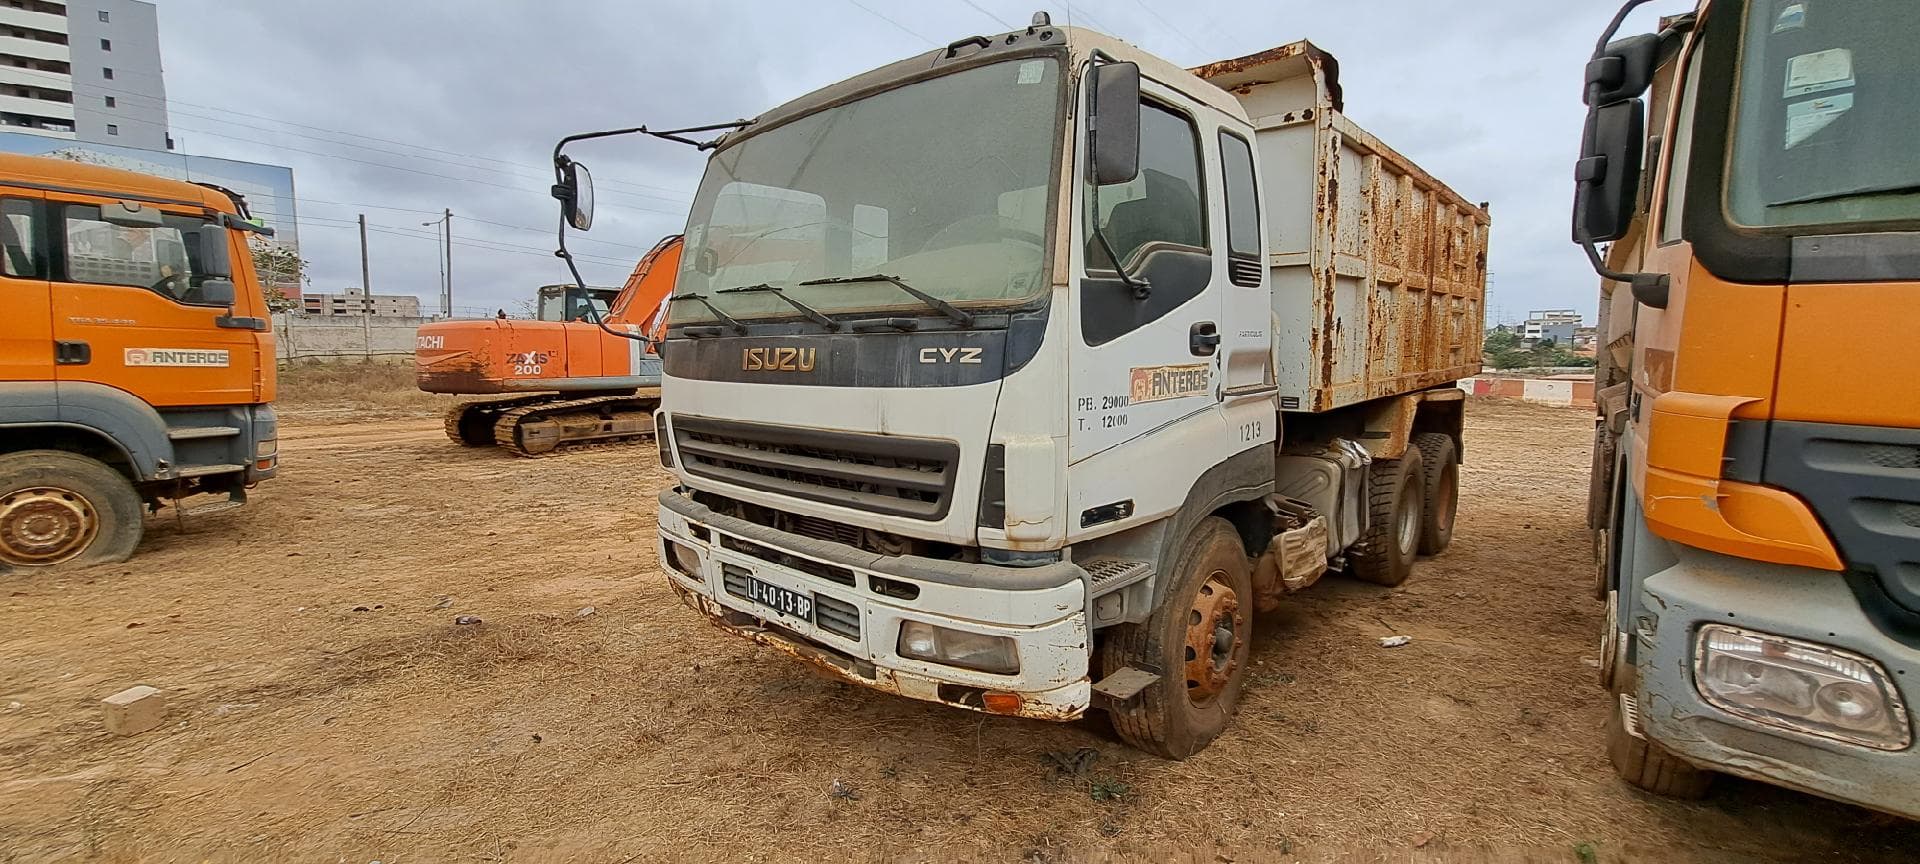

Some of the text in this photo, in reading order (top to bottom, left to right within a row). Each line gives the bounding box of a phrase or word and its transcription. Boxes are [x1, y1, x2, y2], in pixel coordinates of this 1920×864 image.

[152, 351, 229, 364] ANTEROS
[742, 347, 817, 372] ISUZU
[919, 347, 983, 364] CYZ
[514, 364, 542, 376] 200
[1152, 369, 1209, 396] ANTEROS
[1102, 395, 1129, 410] 29000
[1077, 417, 1091, 431] T.
[1239, 421, 1261, 442] 1213
